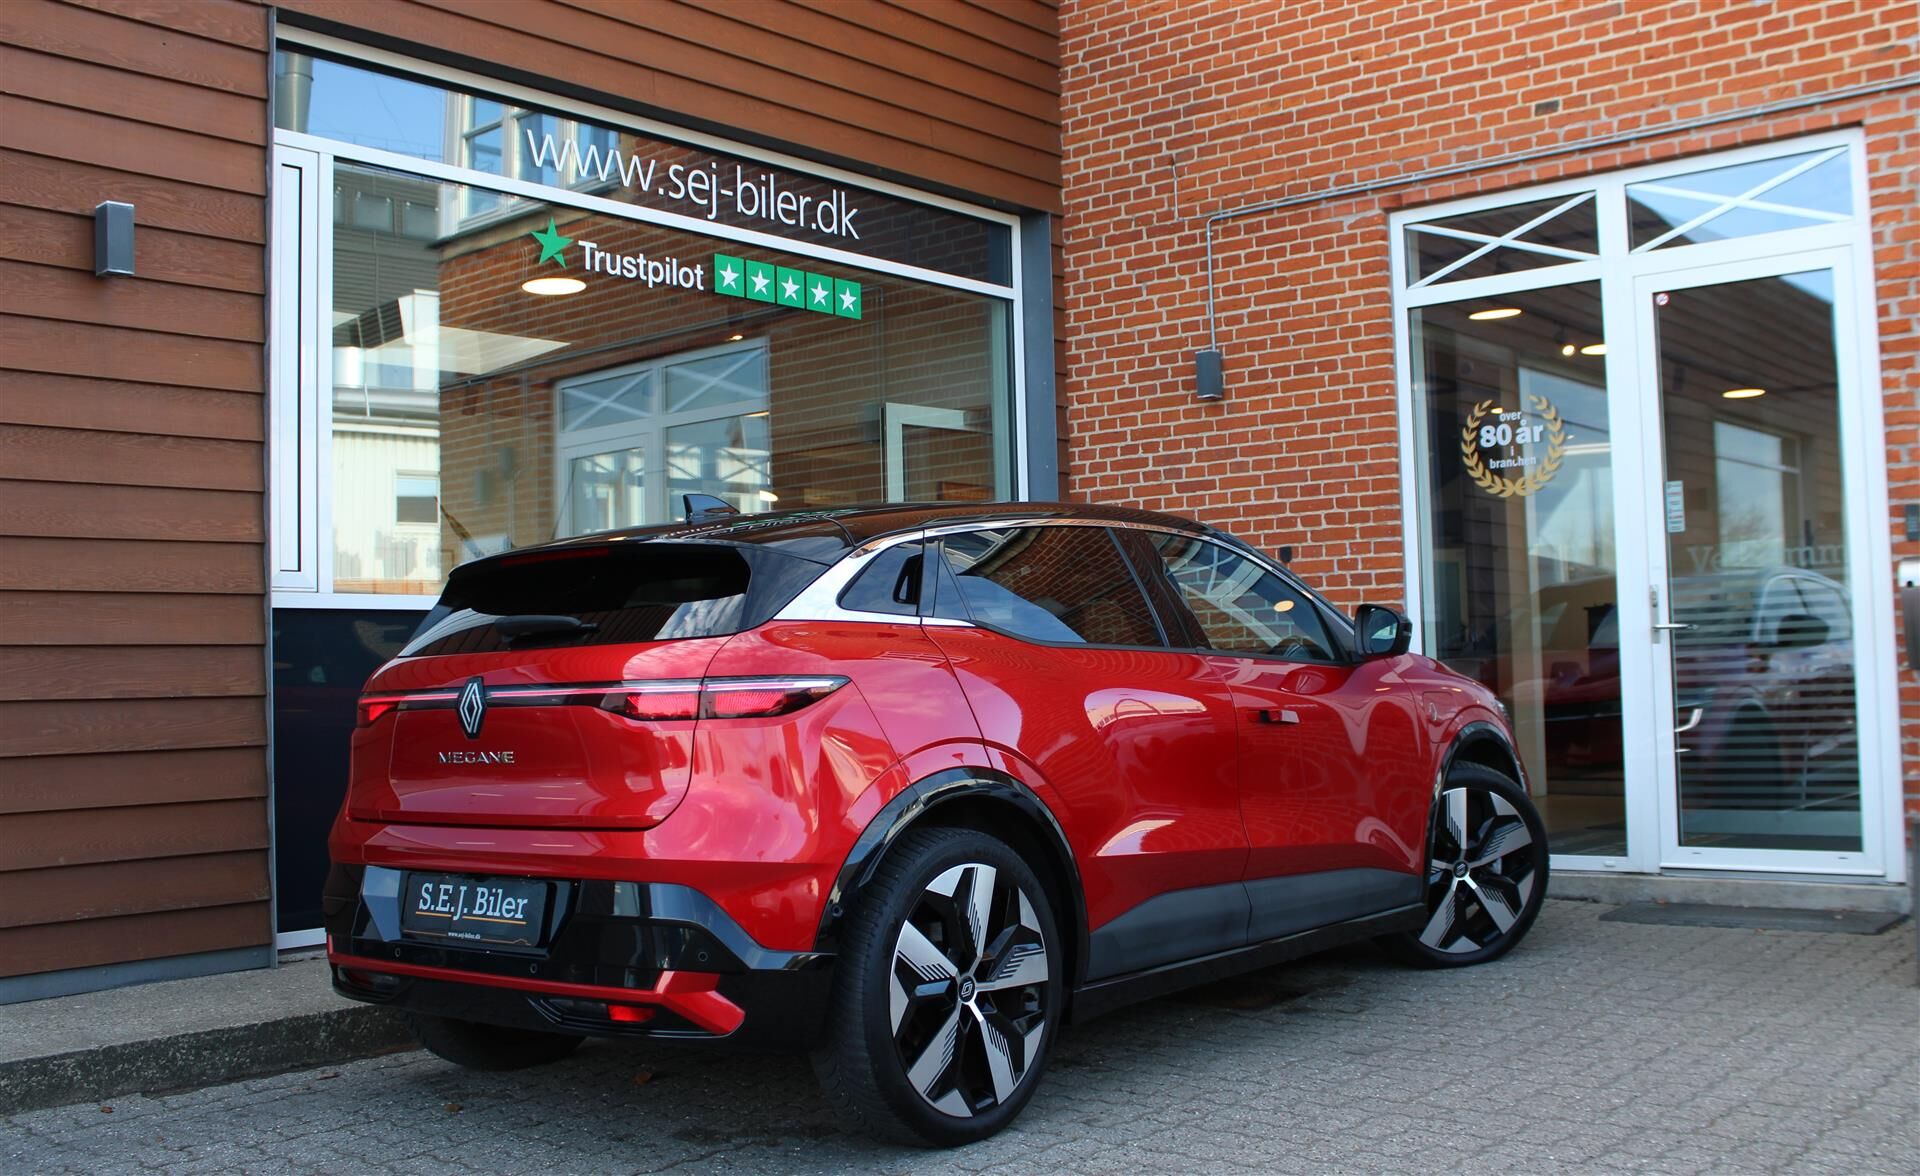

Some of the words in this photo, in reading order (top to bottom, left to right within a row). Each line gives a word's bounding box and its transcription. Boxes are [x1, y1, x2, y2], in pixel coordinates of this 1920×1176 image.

[527, 129, 860, 240] www.sej-biler.dk
[578, 240, 704, 291] Trustpilot
[1500, 411, 1522, 421] over
[1480, 423, 1512, 448] 80
[1516, 419, 1543, 444] år
[1510, 446, 1514, 456] i
[418, 883, 468, 920] S.E.J.
[472, 887, 528, 919] Biler
